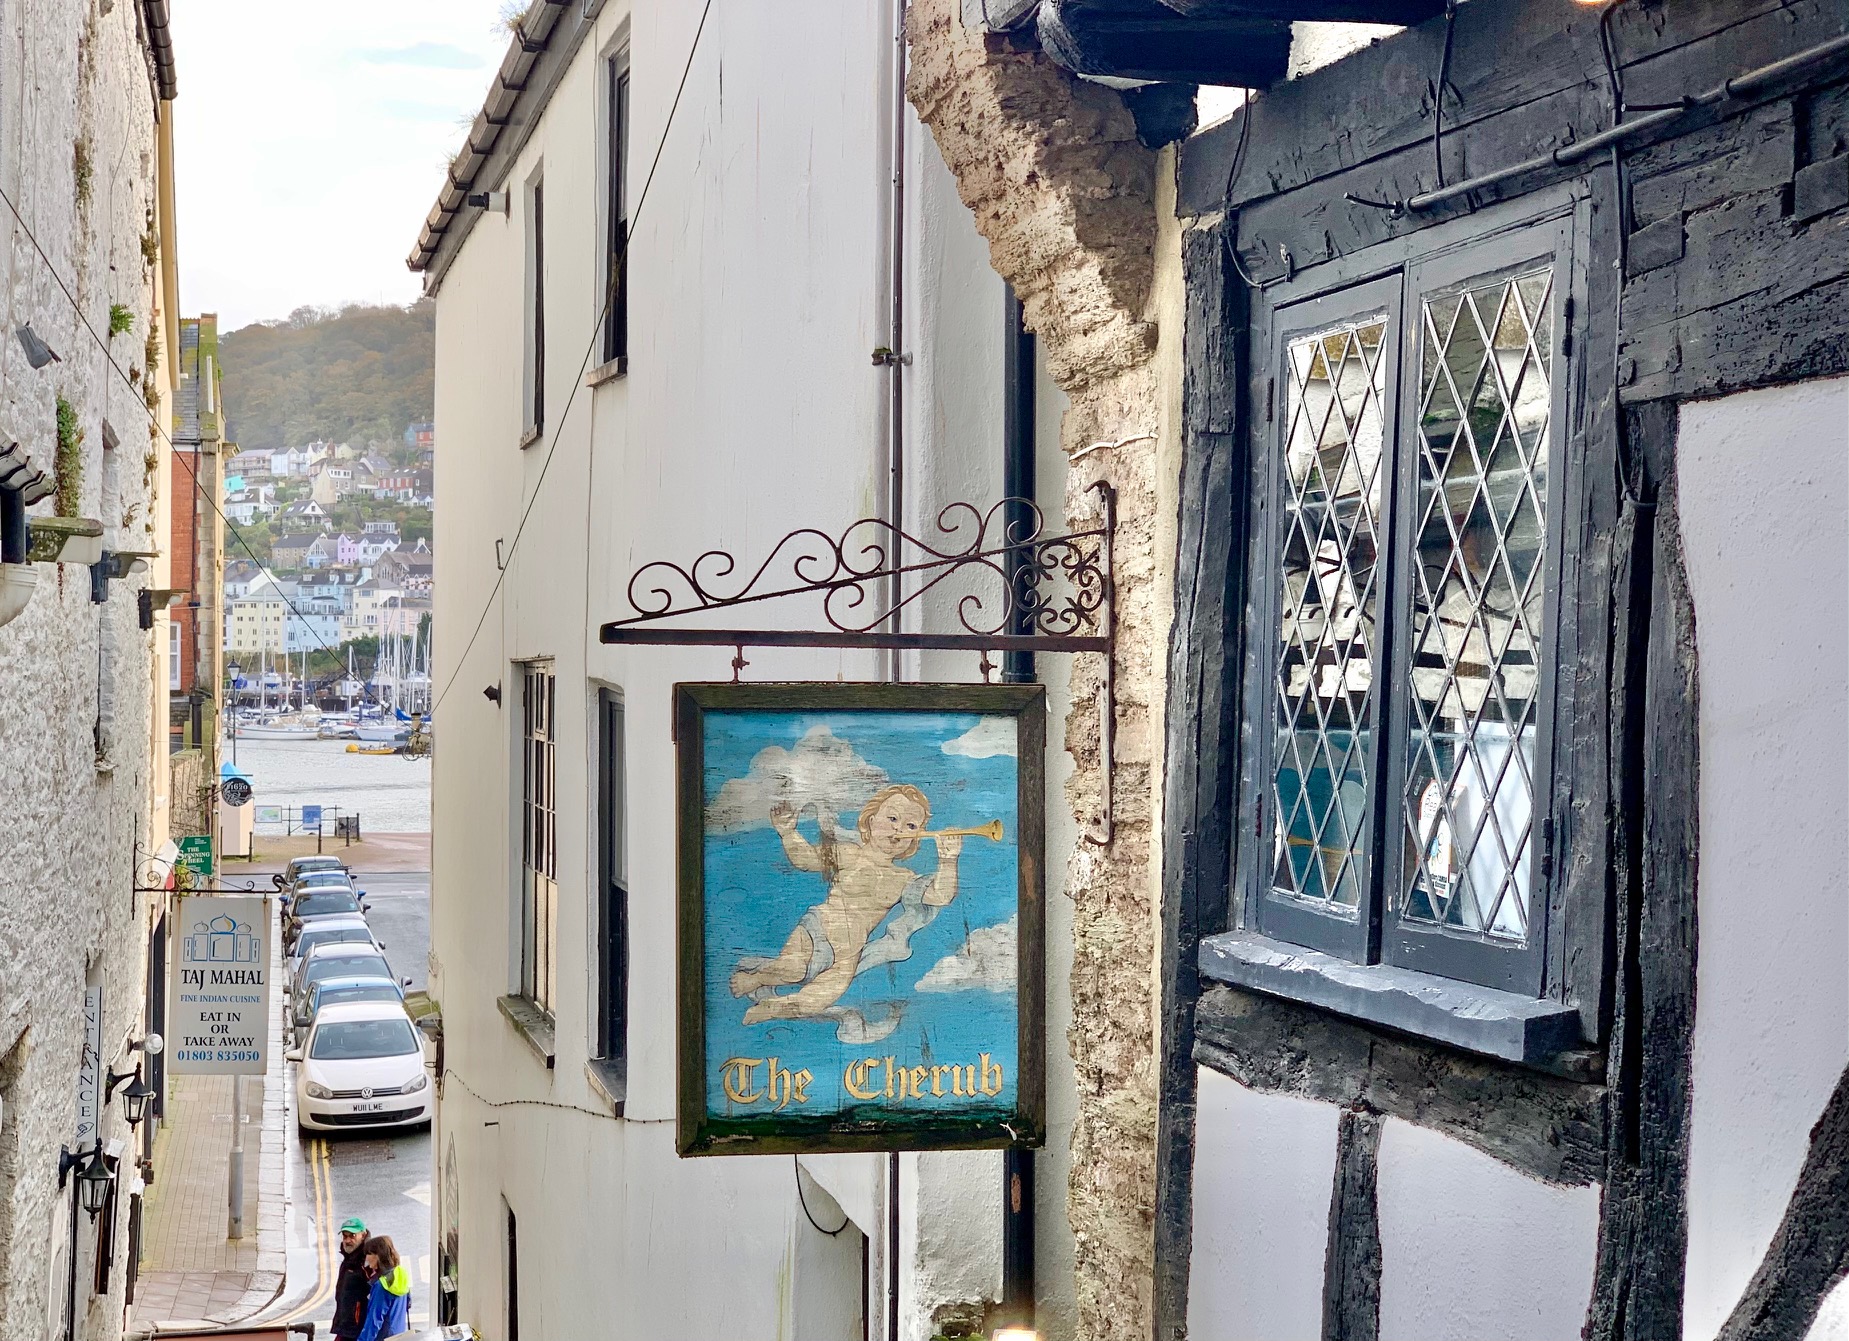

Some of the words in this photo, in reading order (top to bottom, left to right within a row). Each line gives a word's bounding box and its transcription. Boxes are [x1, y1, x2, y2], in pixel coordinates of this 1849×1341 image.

[177, 850, 210, 860] SPINNING
[181, 969, 206, 990] TAJ
[211, 970, 265, 985] MAHAL
[180, 994, 198, 1003] FINE
[200, 995, 228, 1003] INDIAN
[229, 995, 261, 1003] CUISINE
[200, 1012, 223, 1022] EAT
[227, 1012, 241, 1022] IN
[211, 1024, 229, 1034] OR
[183, 1036, 216, 1047] TAKE
[218, 1037, 255, 1047] AWAY
[177, 1050, 213, 1061] 01803
[217, 1050, 260, 1062] 835050
[719, 1056, 815, 1113] The
[843, 1052, 1003, 1104] Cherub
